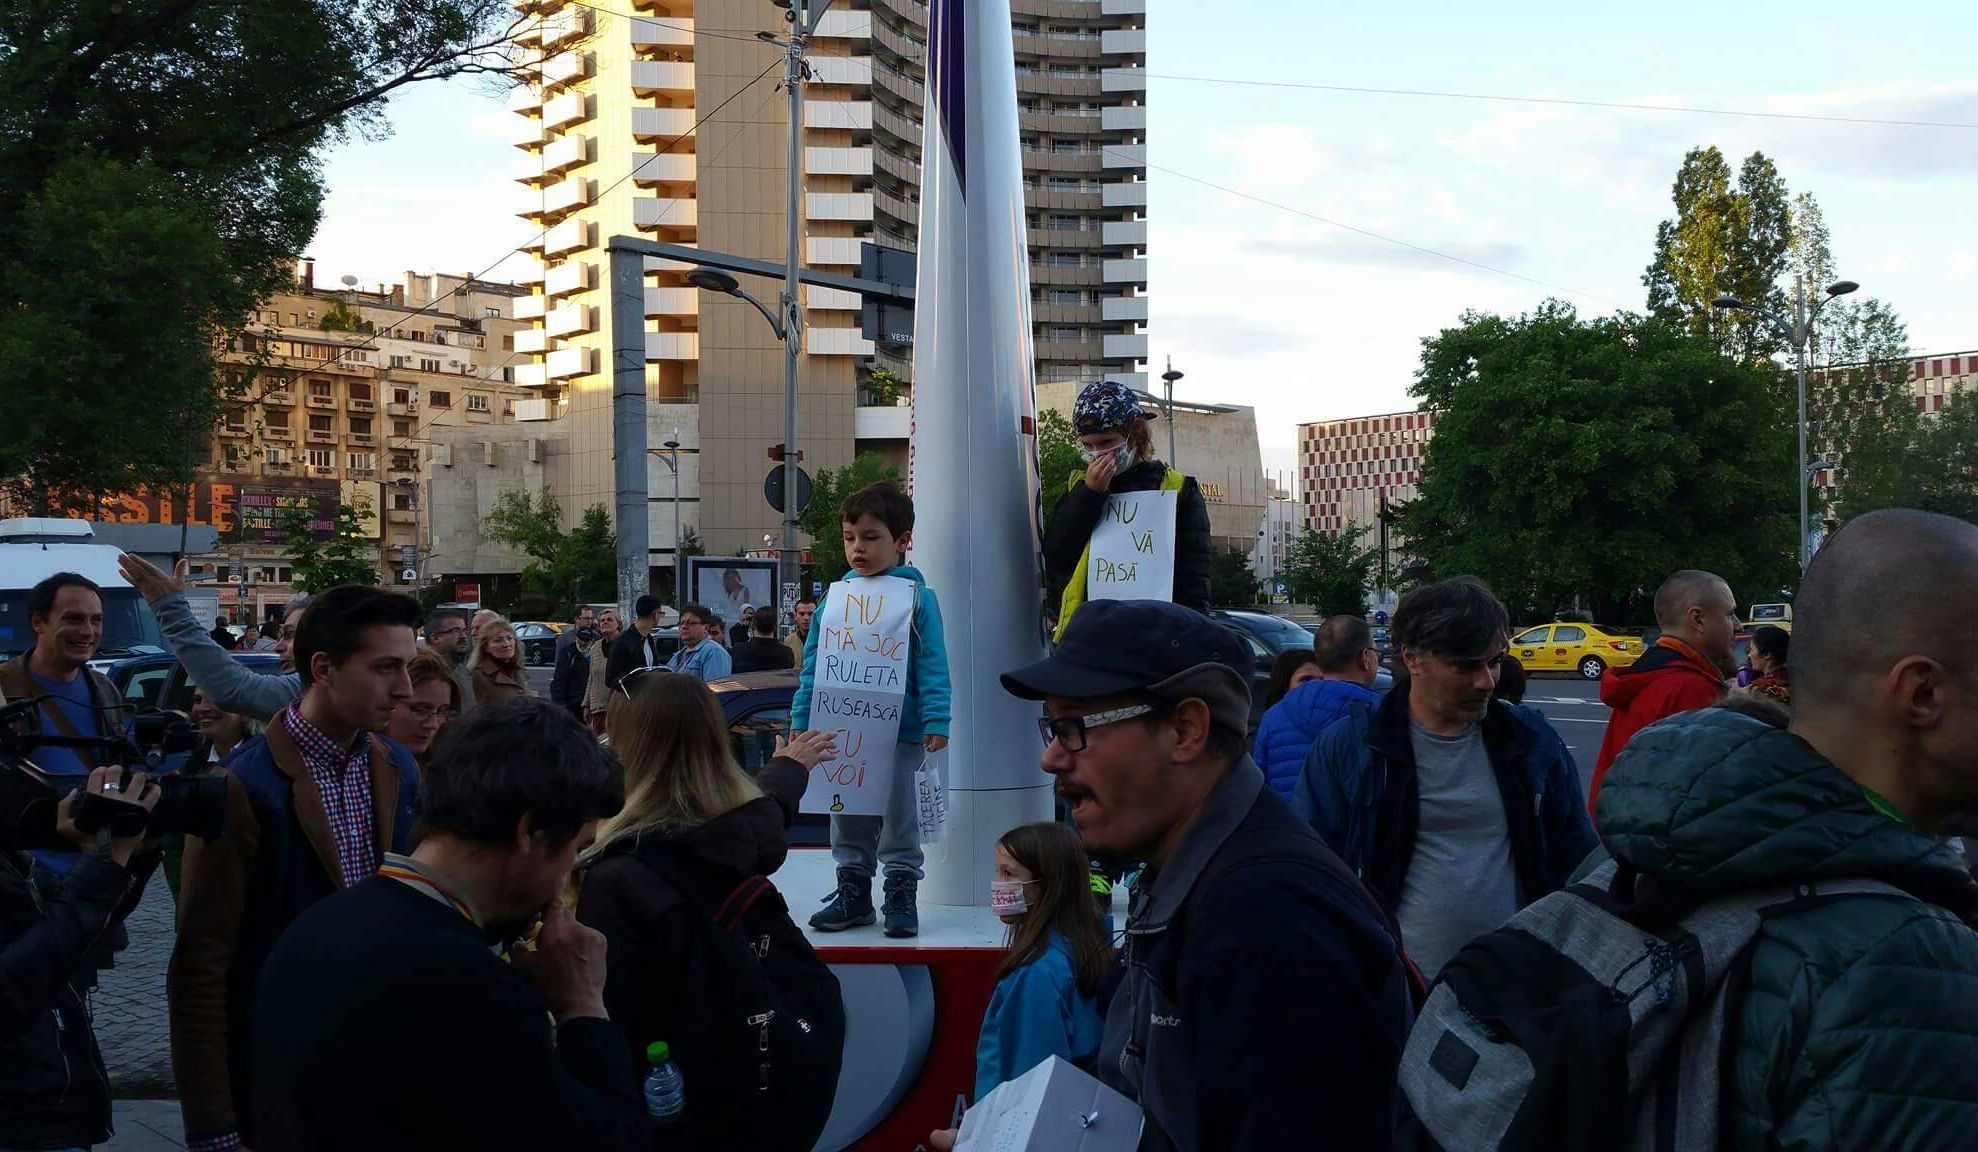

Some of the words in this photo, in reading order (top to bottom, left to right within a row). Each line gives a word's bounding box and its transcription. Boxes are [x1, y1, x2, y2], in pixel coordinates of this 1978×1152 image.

[1106, 501, 1139, 524] NU
[845, 593, 884, 626] NU
[865, 633, 907, 661] JOC
[825, 655, 899, 687] RULETA
